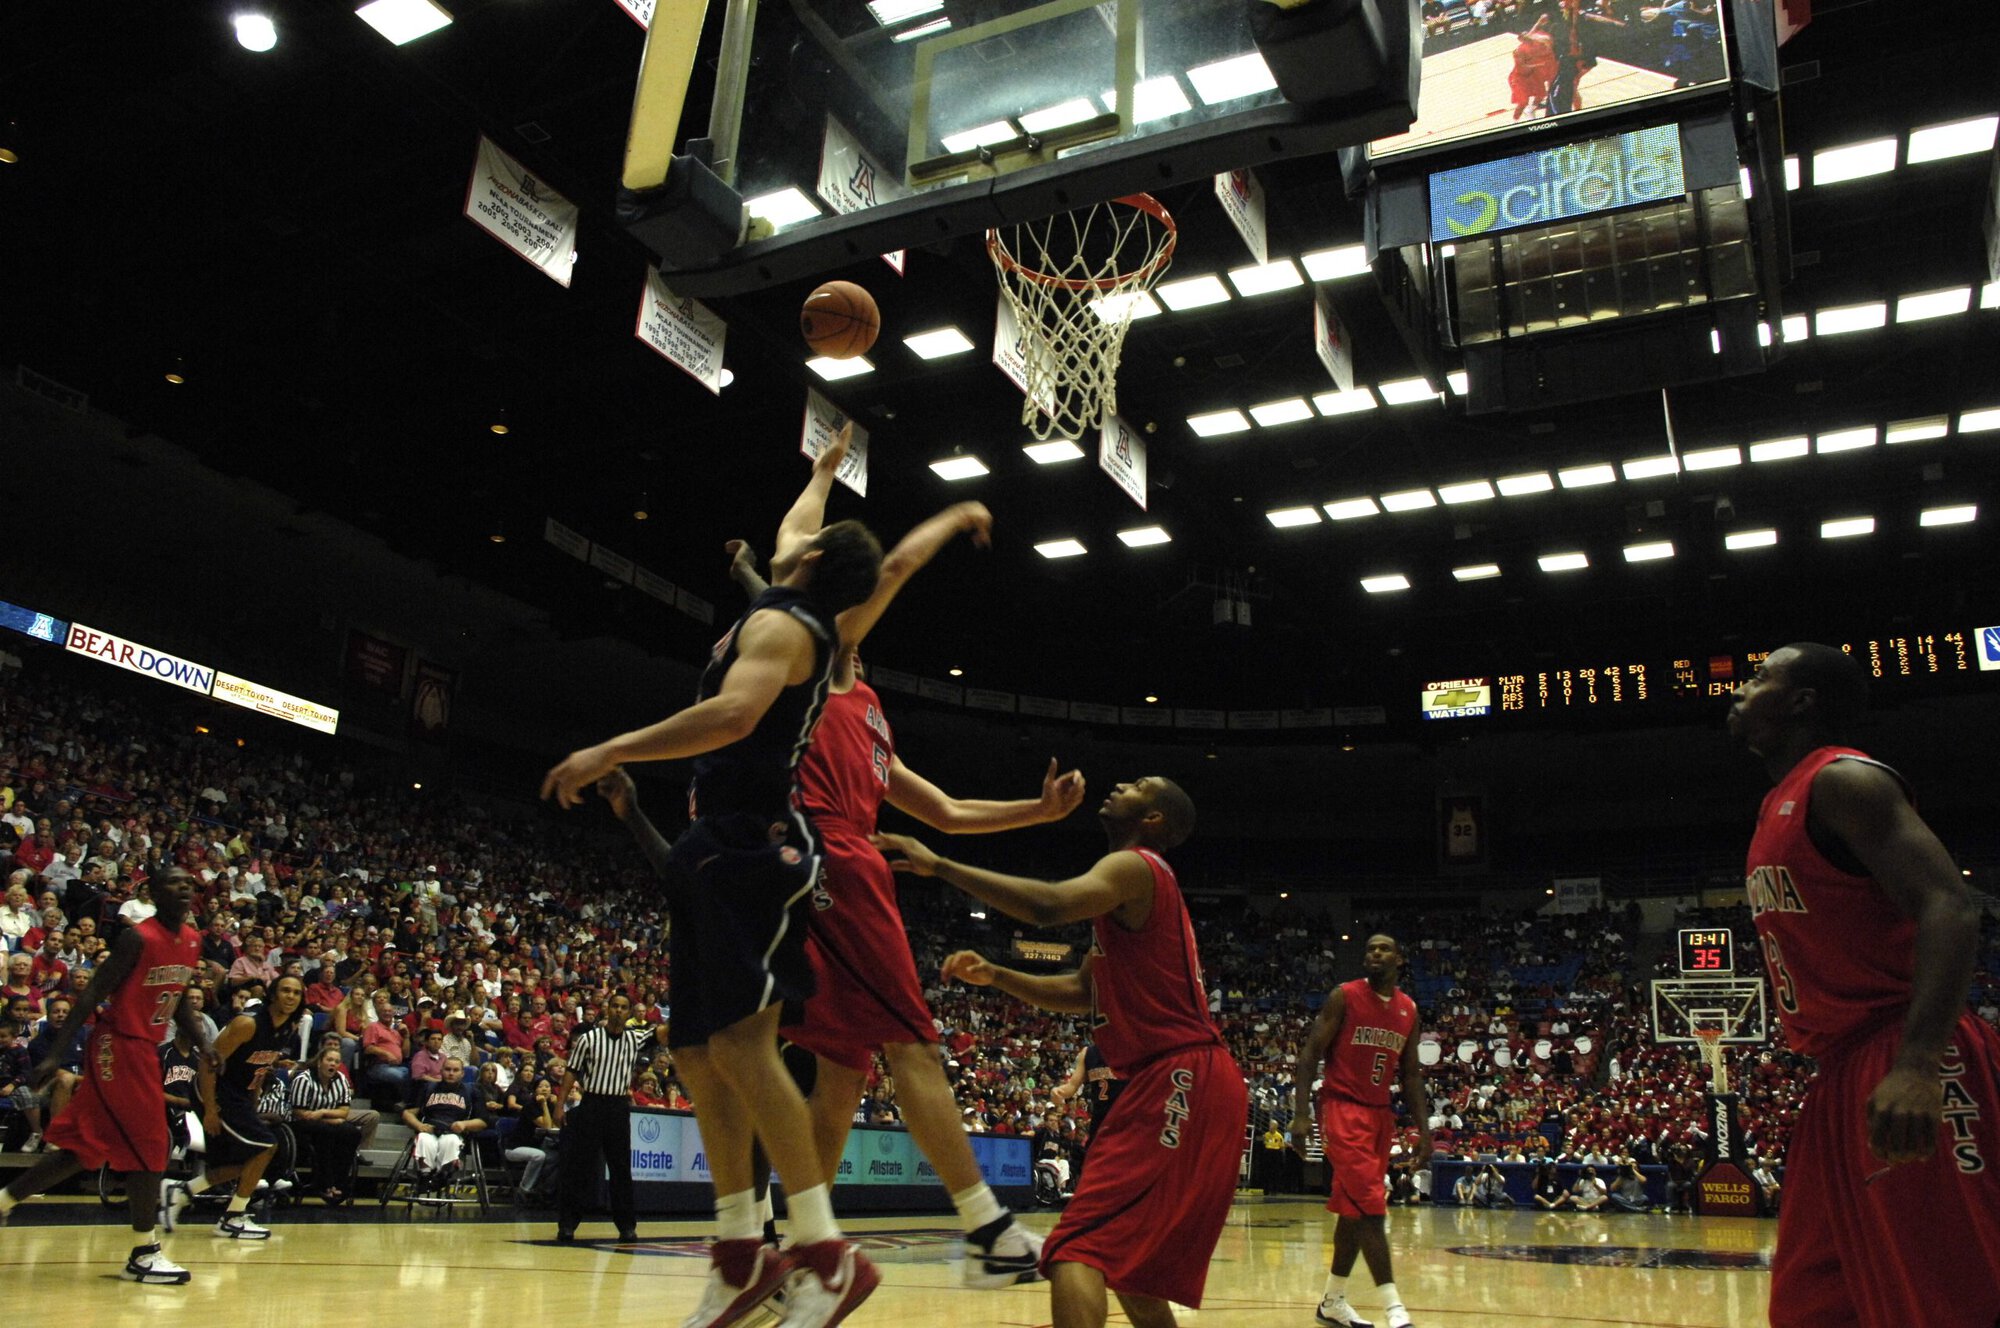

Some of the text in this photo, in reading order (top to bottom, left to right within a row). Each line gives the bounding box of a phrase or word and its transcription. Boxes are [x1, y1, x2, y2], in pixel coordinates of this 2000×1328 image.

[1538, 143, 1595, 177] my
[1503, 156, 1663, 223] circle
[1889, 638, 1906, 648] 12
[1918, 635, 1934, 645] 14
[1945, 633, 1963, 642] 44
[1538, 672, 1547, 681] 5
[1556, 671, 1571, 680] 13
[1580, 669, 1595, 678] 20
[1604, 667, 1620, 675] 42
[1628, 664, 1645, 674] 50
[1673, 660, 1690, 669] RED
[1427, 678, 1483, 691] O'RIELLY
[1503, 684, 1522, 693] PTS
[1563, 679, 1572, 688] 0
[1637, 673, 1646, 682] 4
[1676, 670, 1694, 683] 44
[216, 680, 245, 694] DESERT
[246, 689, 274, 704] TOYOTA
[1503, 693, 1523, 702] RBS
[1563, 688, 1572, 696] 0
[1589, 694, 1597, 703] 0
[282, 701, 308, 715] DESERT
[310, 710, 336, 725] TOYOTA
[1429, 706, 1486, 719] WATSON
[1454, 824, 1472, 836] 32
[1689, 933, 1725, 946] 13:41
[1692, 949, 1721, 969] 35
[1370, 1053, 1388, 1086] 5
[1160, 1068, 1194, 1149] CATS
[1715, 1099, 1731, 1159] ARIZONA
[631, 1150, 672, 1170] llstate
[868, 1159, 903, 1176] Allstate
[1001, 1164, 1026, 1178] Allstate
[1702, 1182, 1750, 1194] WELLS
[1704, 1193, 1750, 1206] FARGO
